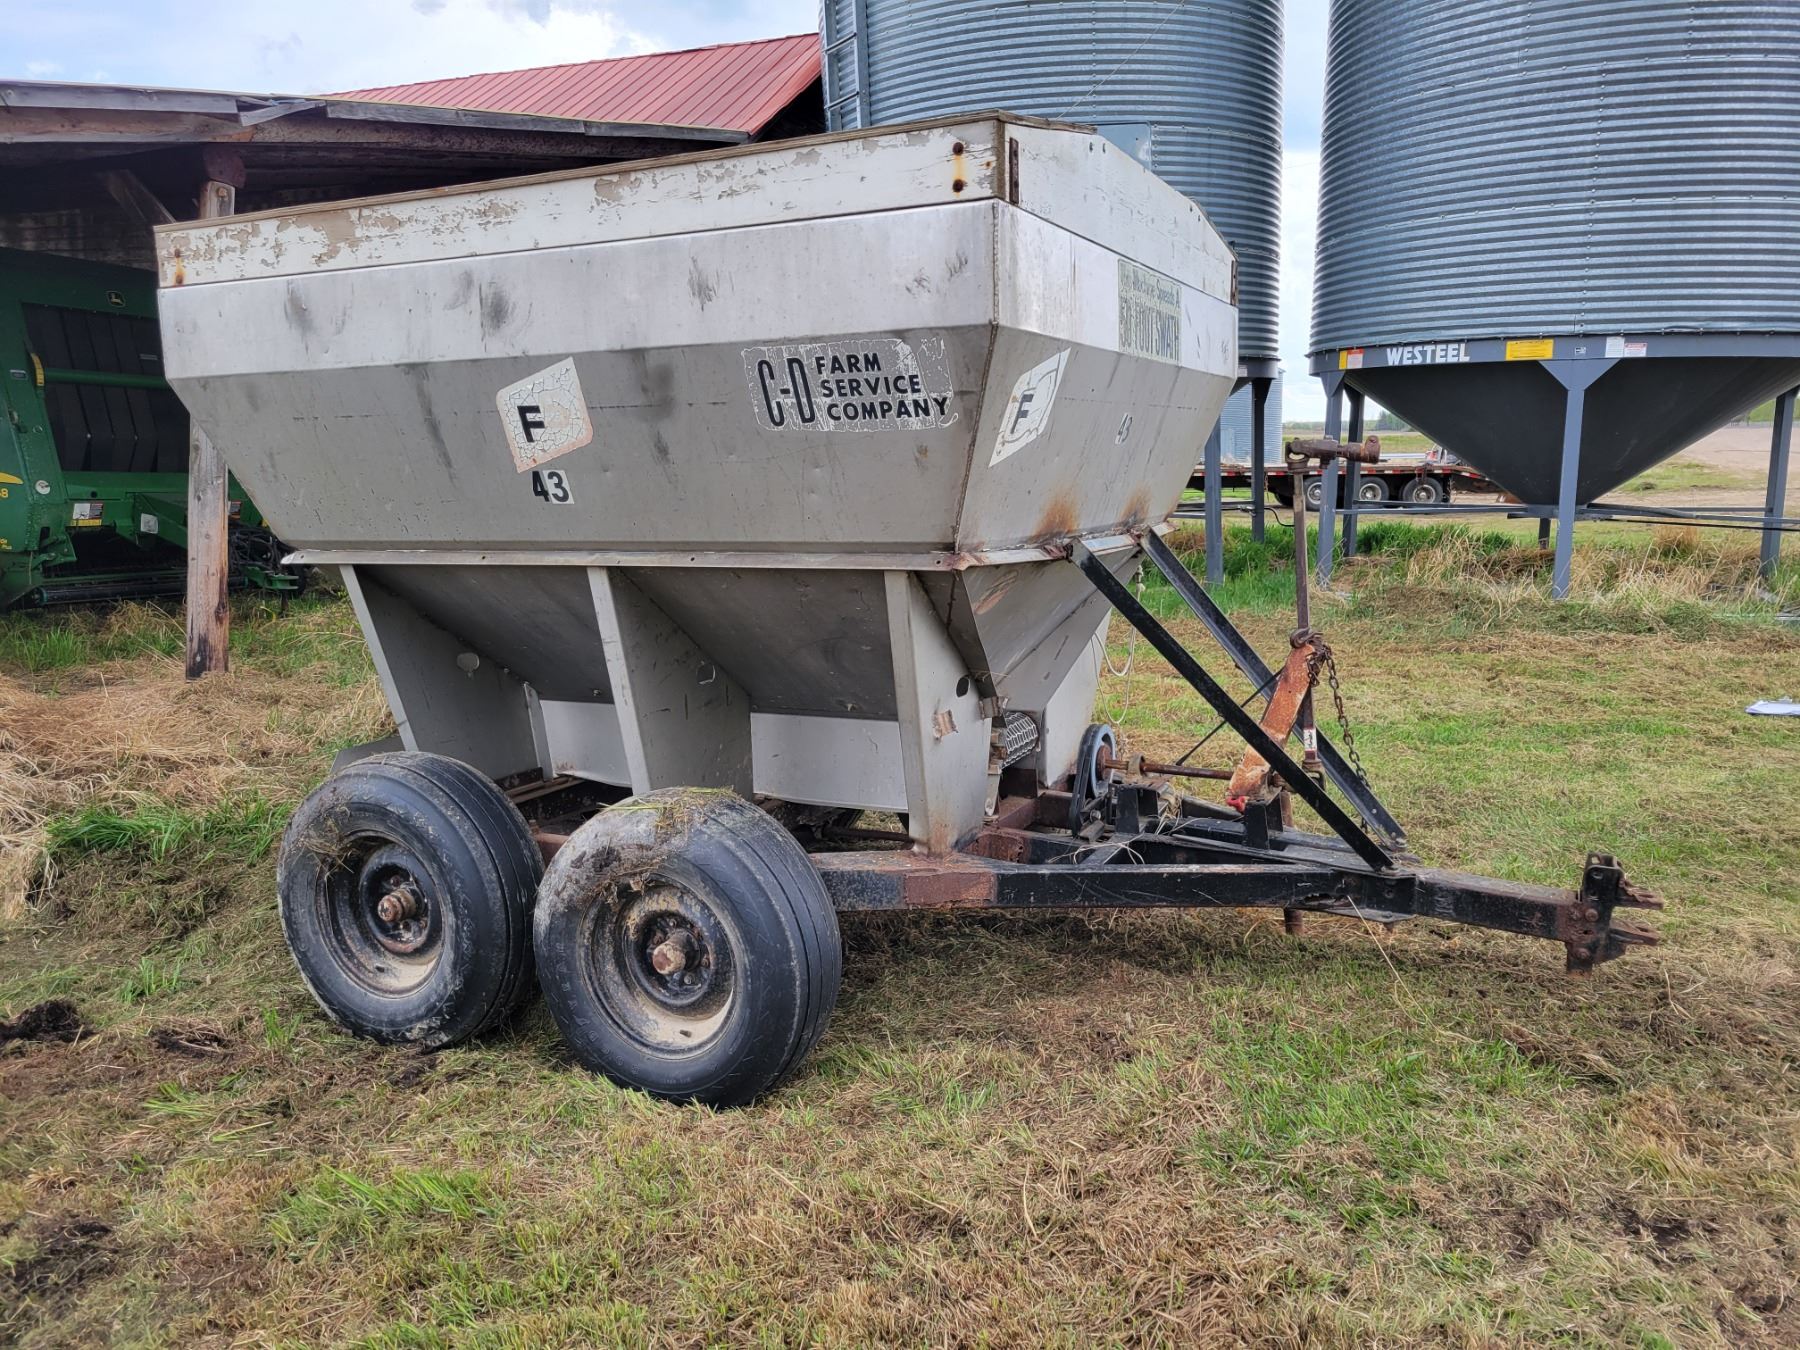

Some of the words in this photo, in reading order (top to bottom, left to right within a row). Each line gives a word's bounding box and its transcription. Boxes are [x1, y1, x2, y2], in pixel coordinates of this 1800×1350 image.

[1155, 309, 1180, 362] SWATH
[815, 352, 882, 374] FARM
[1386, 343, 1471, 366] WESTEEL
[757, 357, 816, 427] C-D
[820, 374, 922, 398] SERVICE
[517, 405, 546, 443] F
[826, 396, 948, 421] COMPANY
[1010, 394, 1034, 434] F
[1117, 414, 1133, 443] 43
[532, 470, 570, 503] 43
